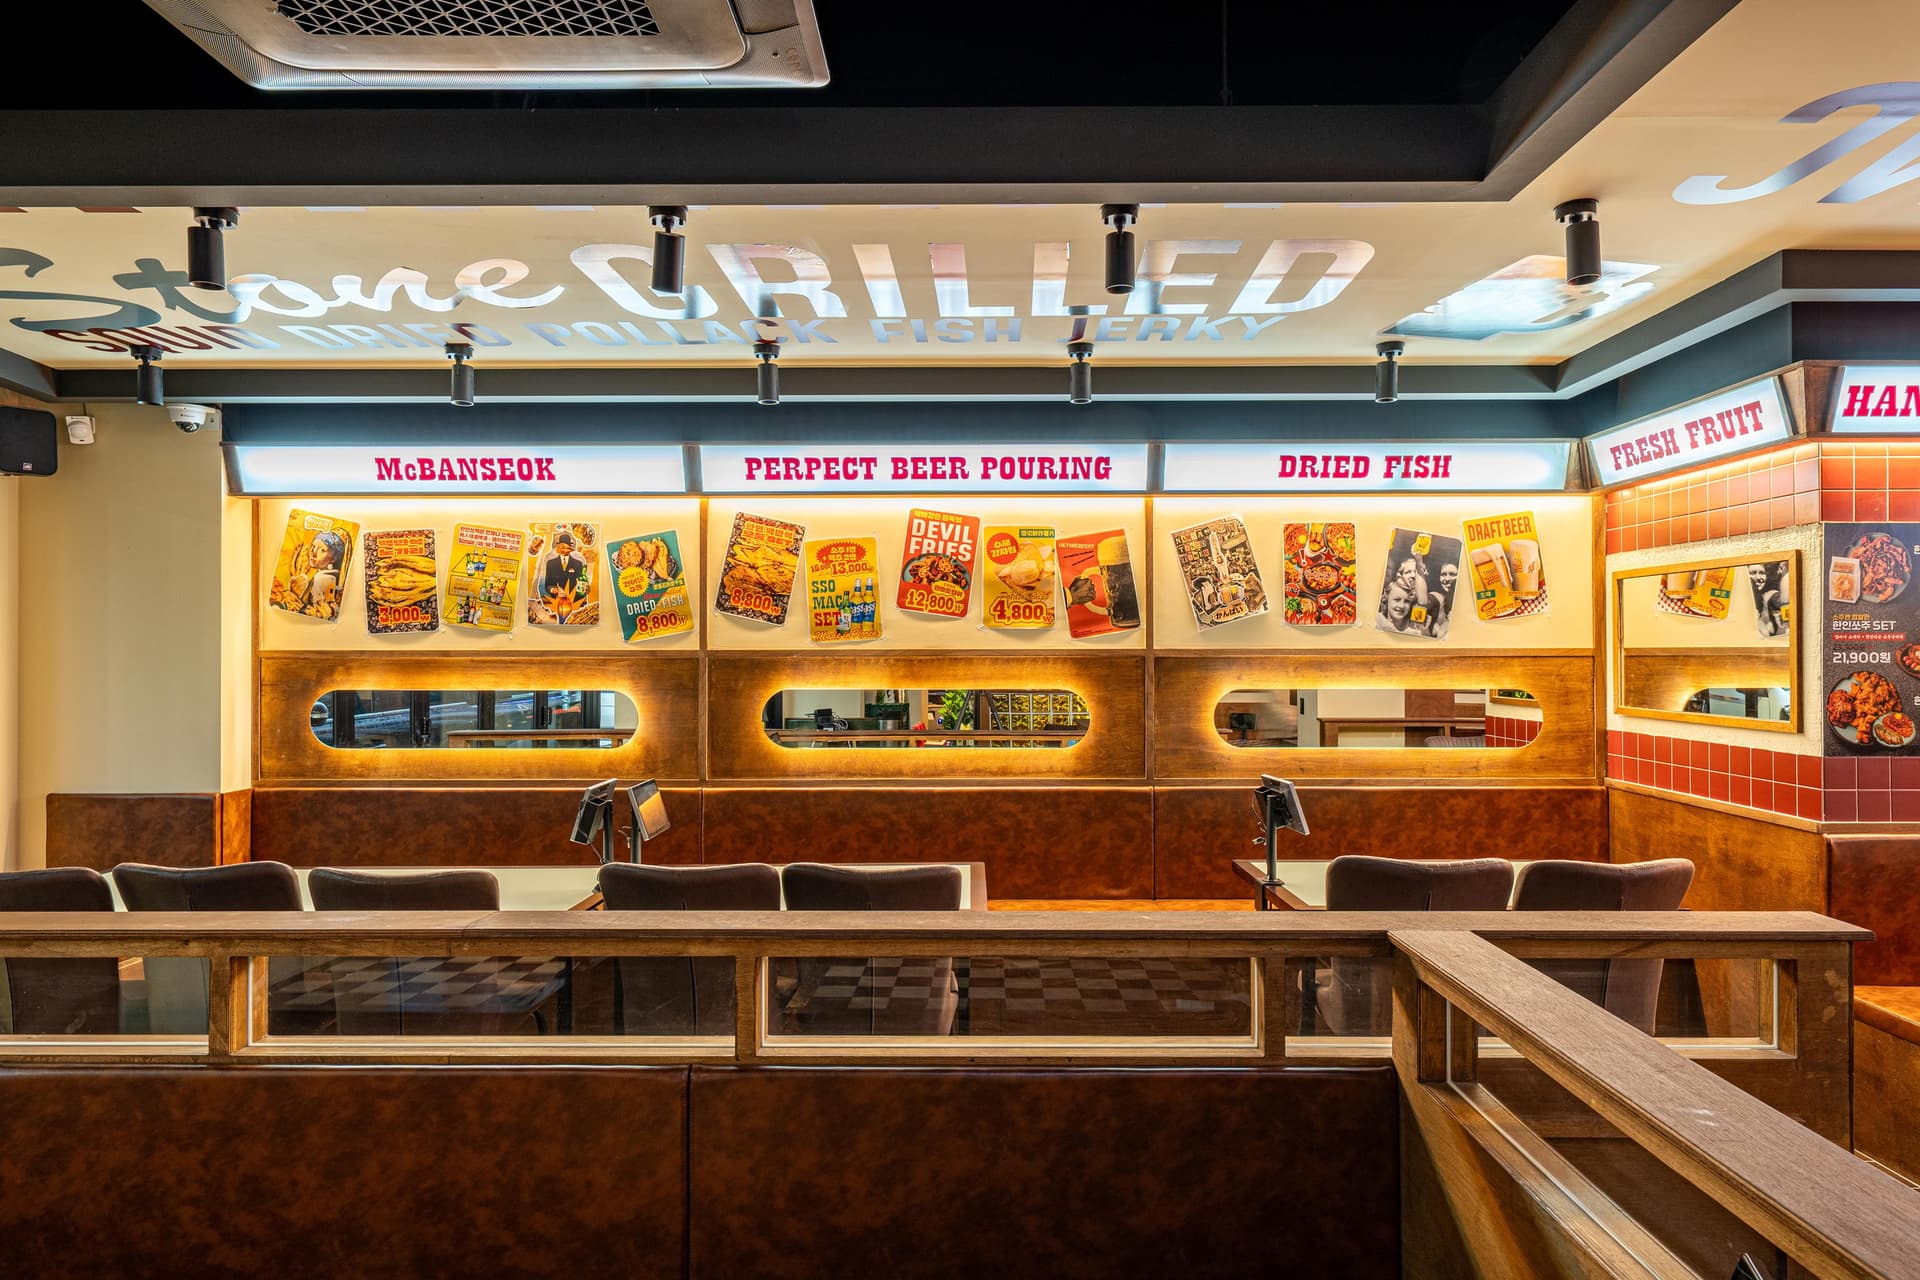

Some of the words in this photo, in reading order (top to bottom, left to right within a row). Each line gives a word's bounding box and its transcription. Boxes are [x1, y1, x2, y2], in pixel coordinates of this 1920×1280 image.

[570, 240, 1375, 319] GRILLED
[523, 319, 839, 346] POLLACK
[868, 318, 1022, 343] FISH
[1065, 316, 1288, 342] JERKY
[1609, 427, 1681, 471] FRESH
[1685, 400, 1763, 449] FRUIT
[375, 457, 556, 481] McBANSEOK
[744, 457, 878, 480] PERPECT
[891, 456, 970, 480] BEER
[981, 456, 1112, 480] POURING
[1278, 455, 1370, 478] DRIED
[1383, 455, 1452, 478] FISH
[911, 518, 973, 544] DEVIL
[1467, 521, 1502, 542] DRAFT
[1503, 516, 1532, 537] BEER
[908, 537, 972, 562] FRIES
[812, 579, 836, 593] SSO
[626, 599, 657, 616] DRIED
[662, 594, 684, 608] FISH
[815, 611, 842, 627] SET
[1873, 620, 1897, 631] SET
[1832, 651, 1891, 665] 21,900원
